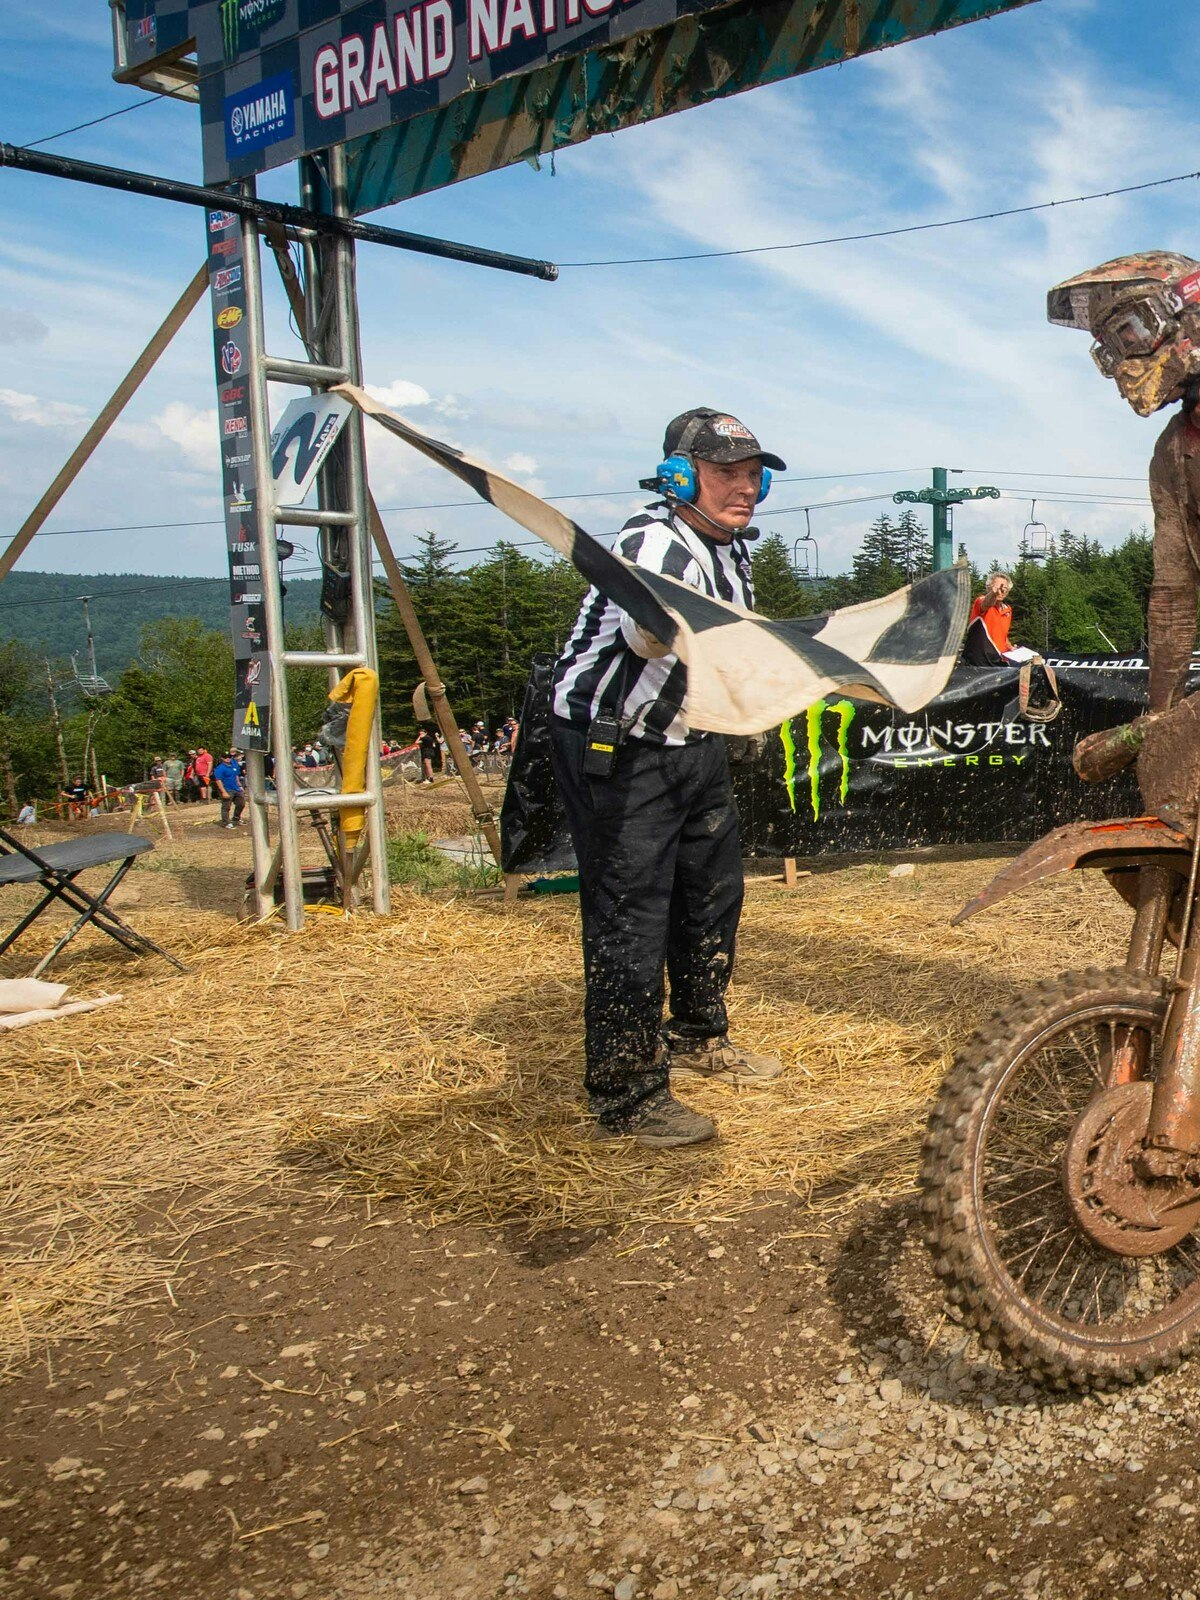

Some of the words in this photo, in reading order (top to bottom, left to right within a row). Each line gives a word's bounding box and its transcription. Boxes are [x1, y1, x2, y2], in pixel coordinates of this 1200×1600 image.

[314, 0, 454, 120] GRAND
[243, 89, 287, 130] YAMAHA
[236, 120, 284, 144] RACING
[315, 416, 337, 448] LAPS
[272, 411, 317, 486] 2
[231, 542, 256, 553] TUSK
[861, 719, 1051, 752] MONSTER
[894, 755, 1026, 768] ENERGY
